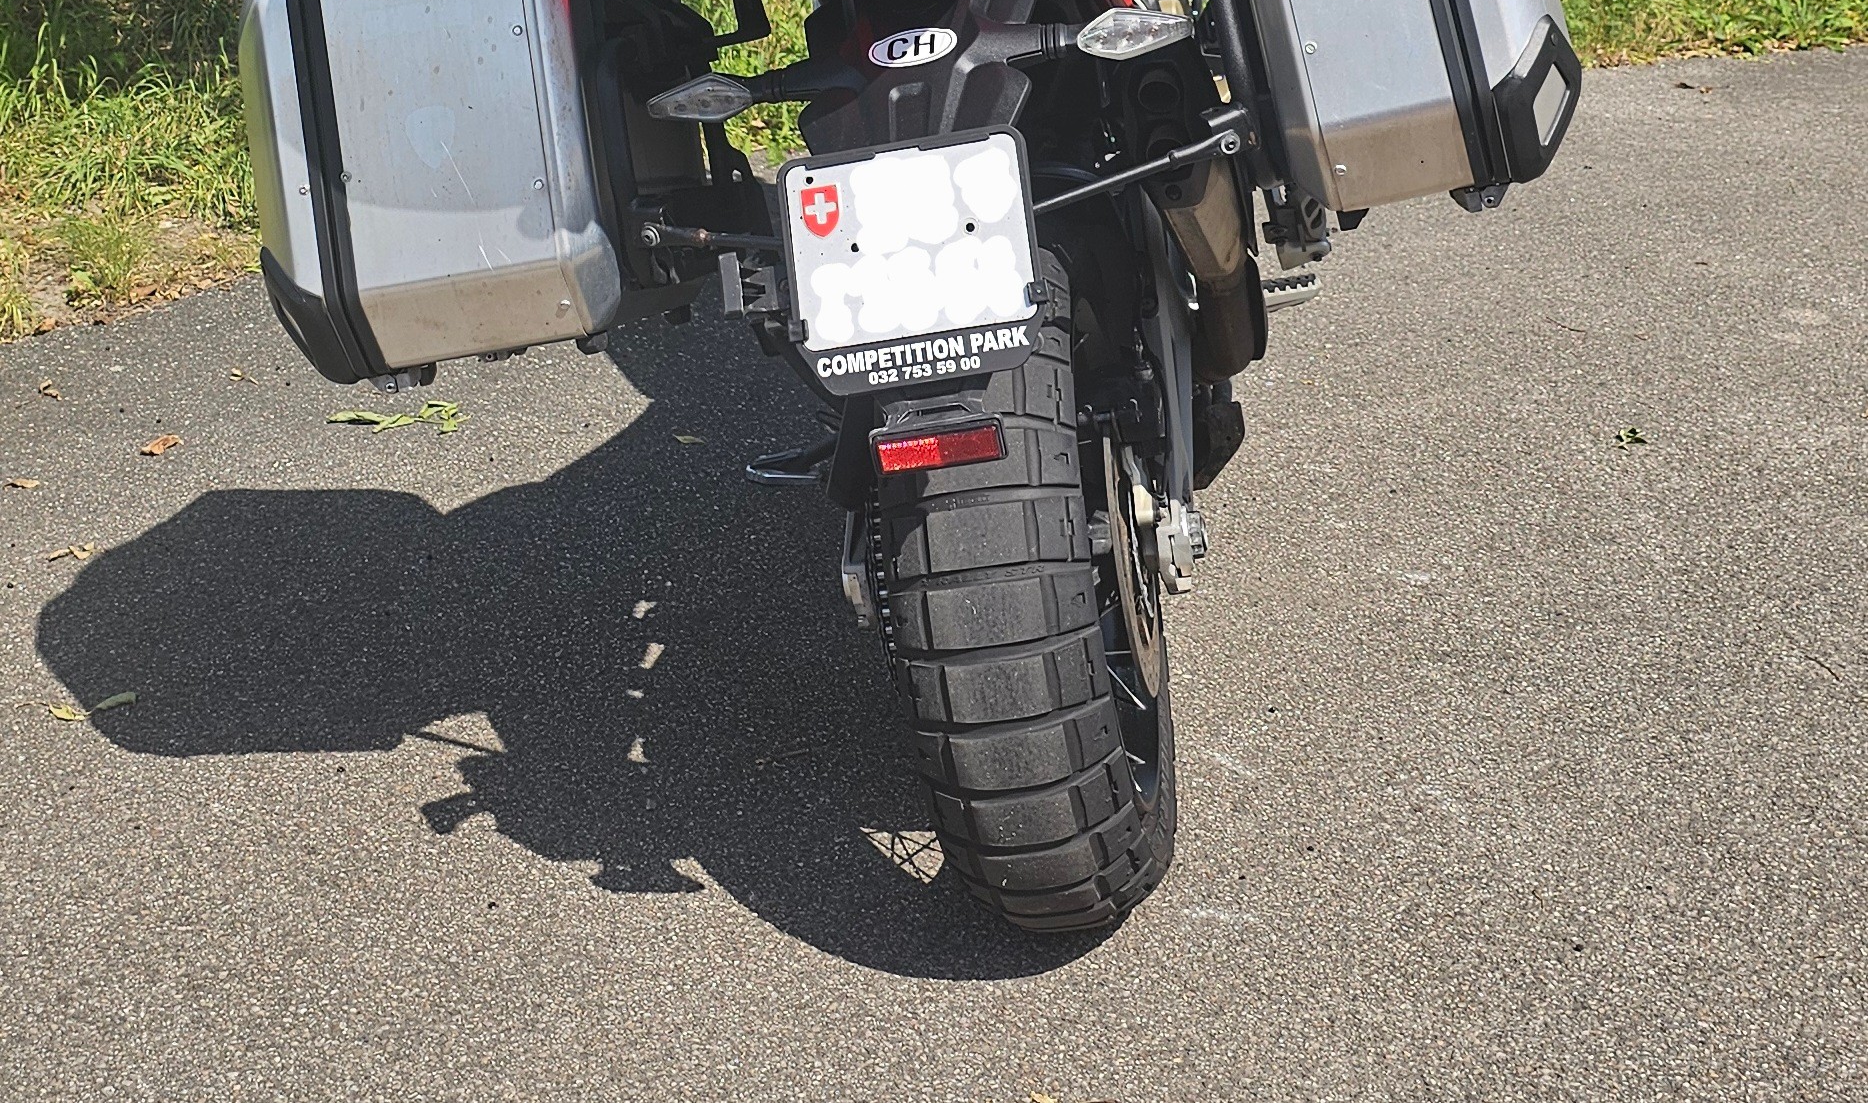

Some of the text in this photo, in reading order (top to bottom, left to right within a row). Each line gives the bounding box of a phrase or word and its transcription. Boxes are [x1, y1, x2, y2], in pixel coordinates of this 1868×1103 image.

[887, 33, 936, 61] CH
[816, 325, 1030, 378] COMPETITION PARK
[868, 354, 981, 386] 032 753 59 00
